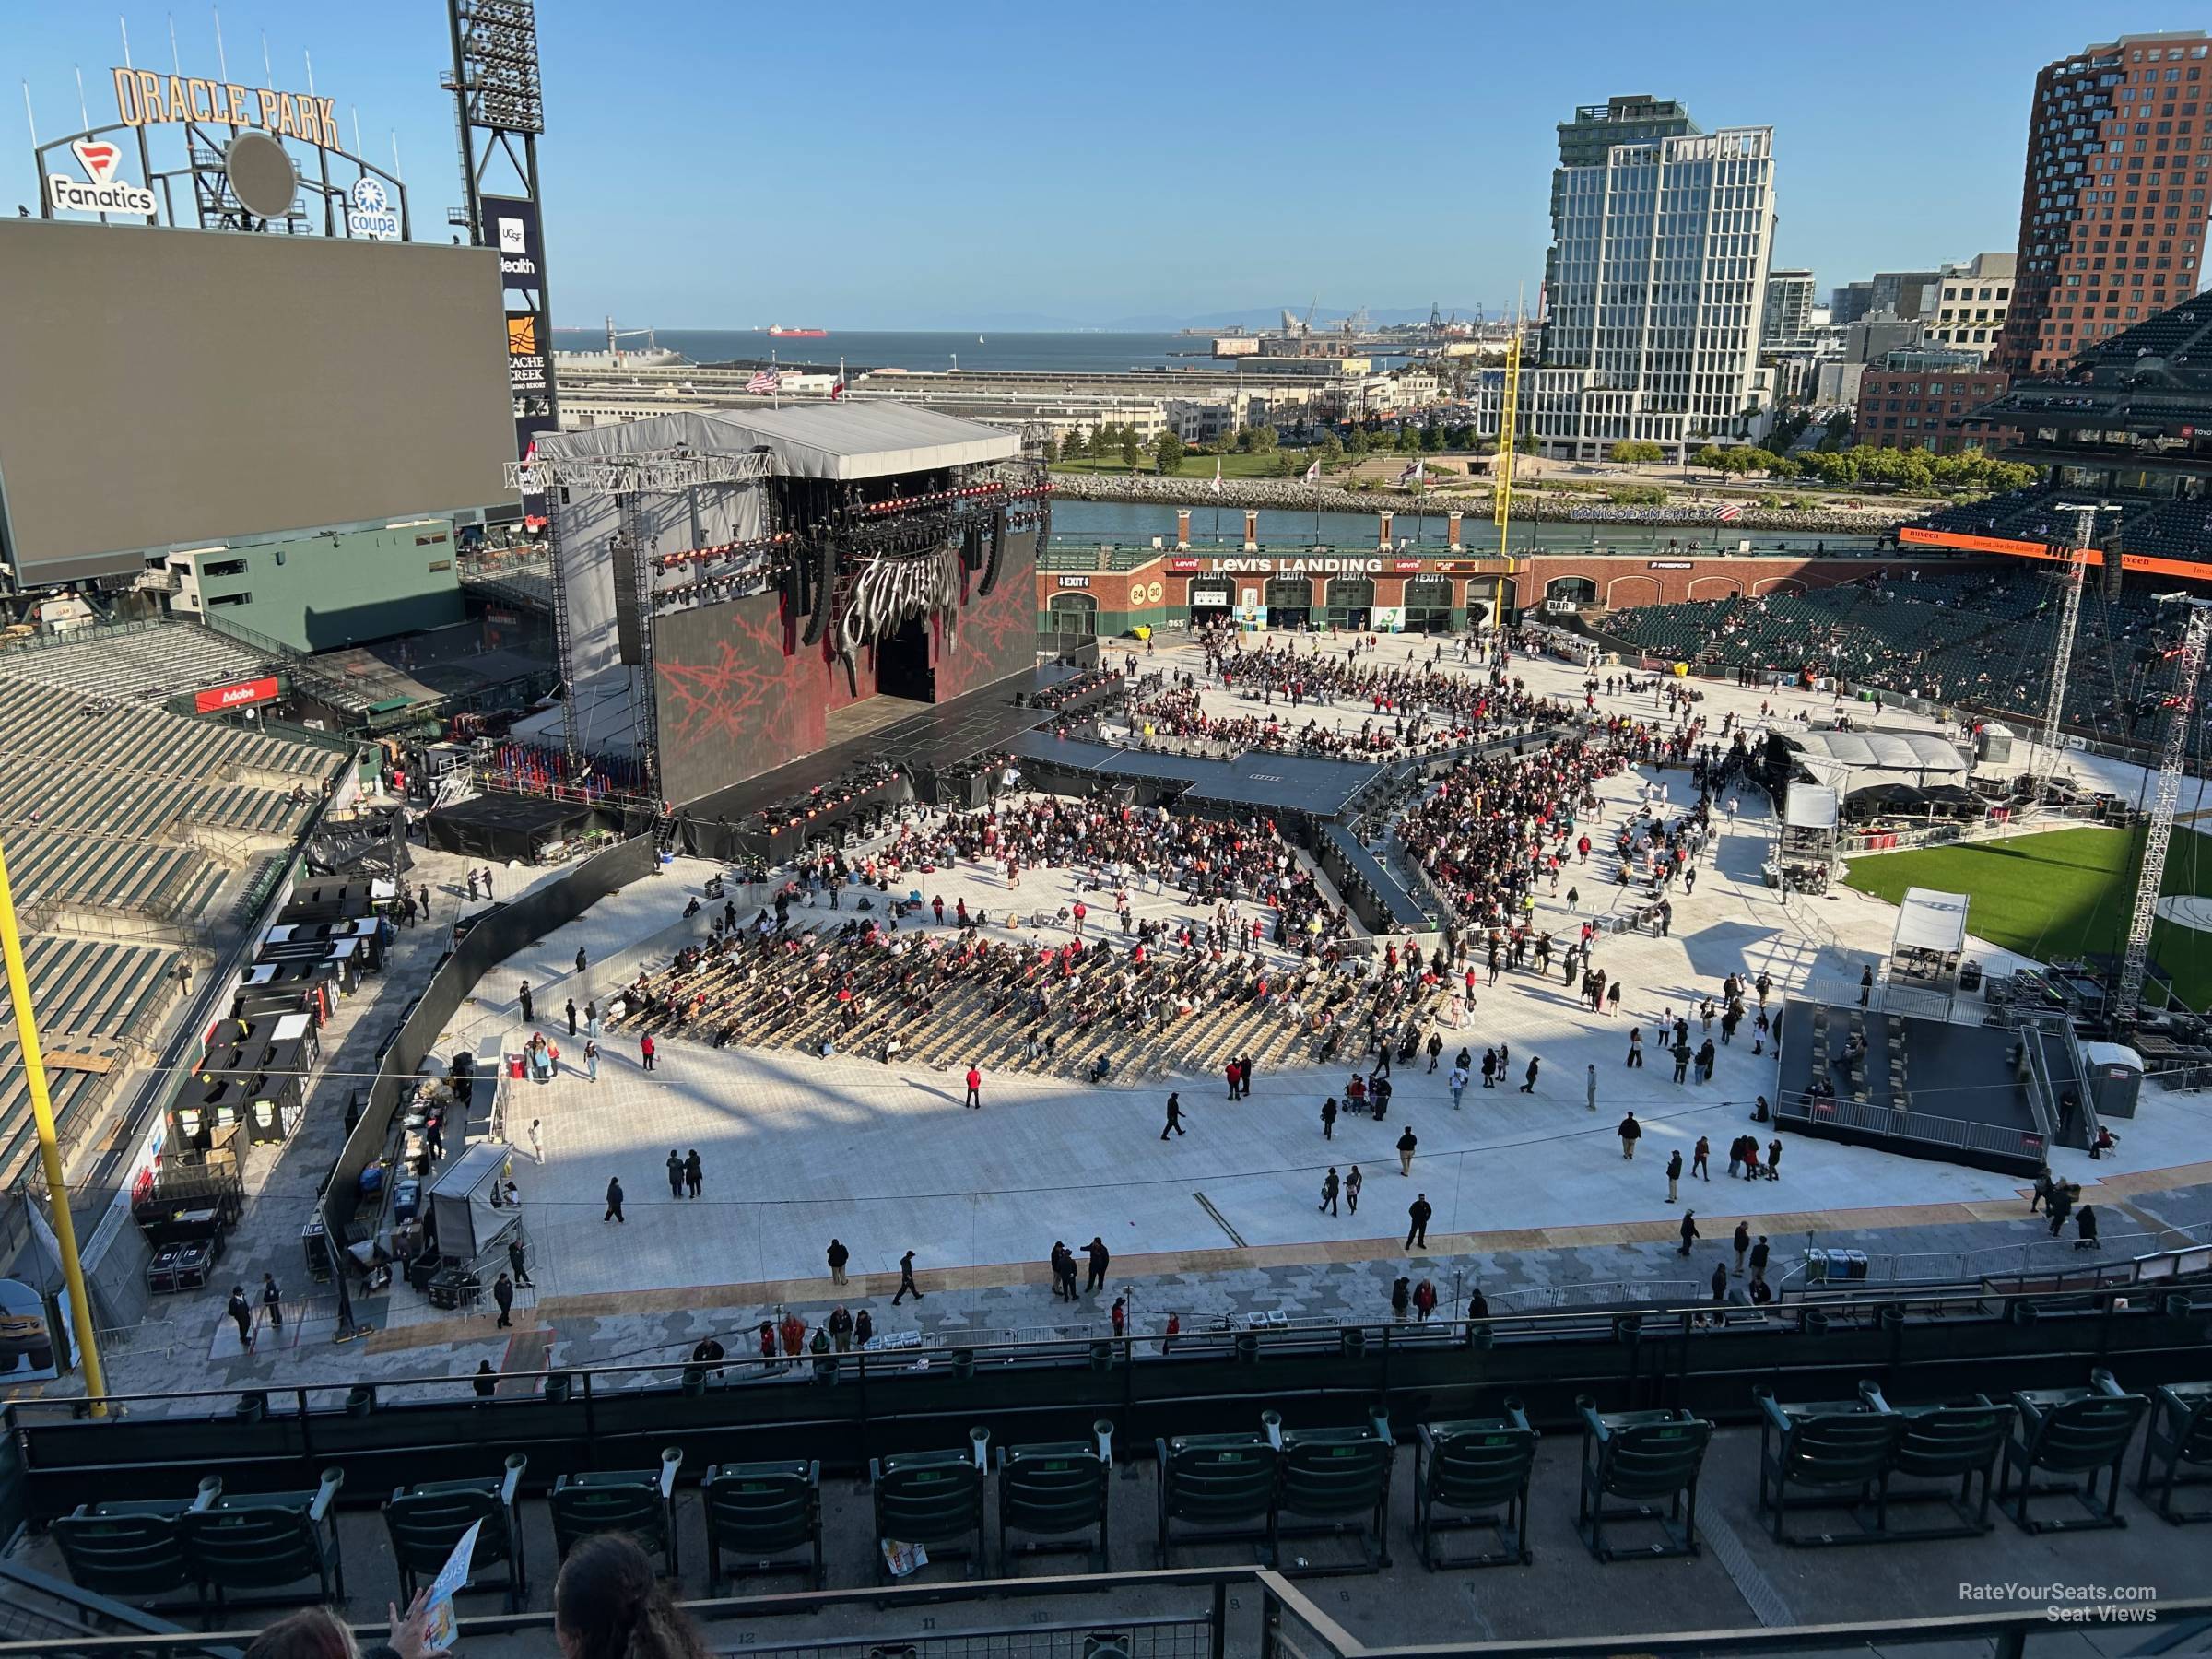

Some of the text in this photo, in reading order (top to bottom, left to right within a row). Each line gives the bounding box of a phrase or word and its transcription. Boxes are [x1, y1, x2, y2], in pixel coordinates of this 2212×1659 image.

[113, 67, 342, 152] ORACLE PARK
[55, 180, 151, 209] Fanatics
[352, 216, 396, 236] coupa
[502, 229, 522, 242] UCSF
[1638, 509, 1707, 519] AMERICA
[1910, 531, 1939, 539] nuveen
[1280, 559, 1382, 571] LANDING
[1202, 571, 1222, 580] EXIT
[1279, 571, 1300, 581] EXIT
[1342, 571, 1362, 581] EXIT
[1419, 573, 1440, 582] EXIT
[1065, 577, 1084, 586] EXIT
[1133, 589, 1144, 599] 24
[1150, 587, 1160, 597] 30
[1549, 602, 1569, 610] BAR
[222, 688, 255, 703] Adobe
[923, 1618, 935, 1630] 11
[737, 1631, 755, 1645] 12
